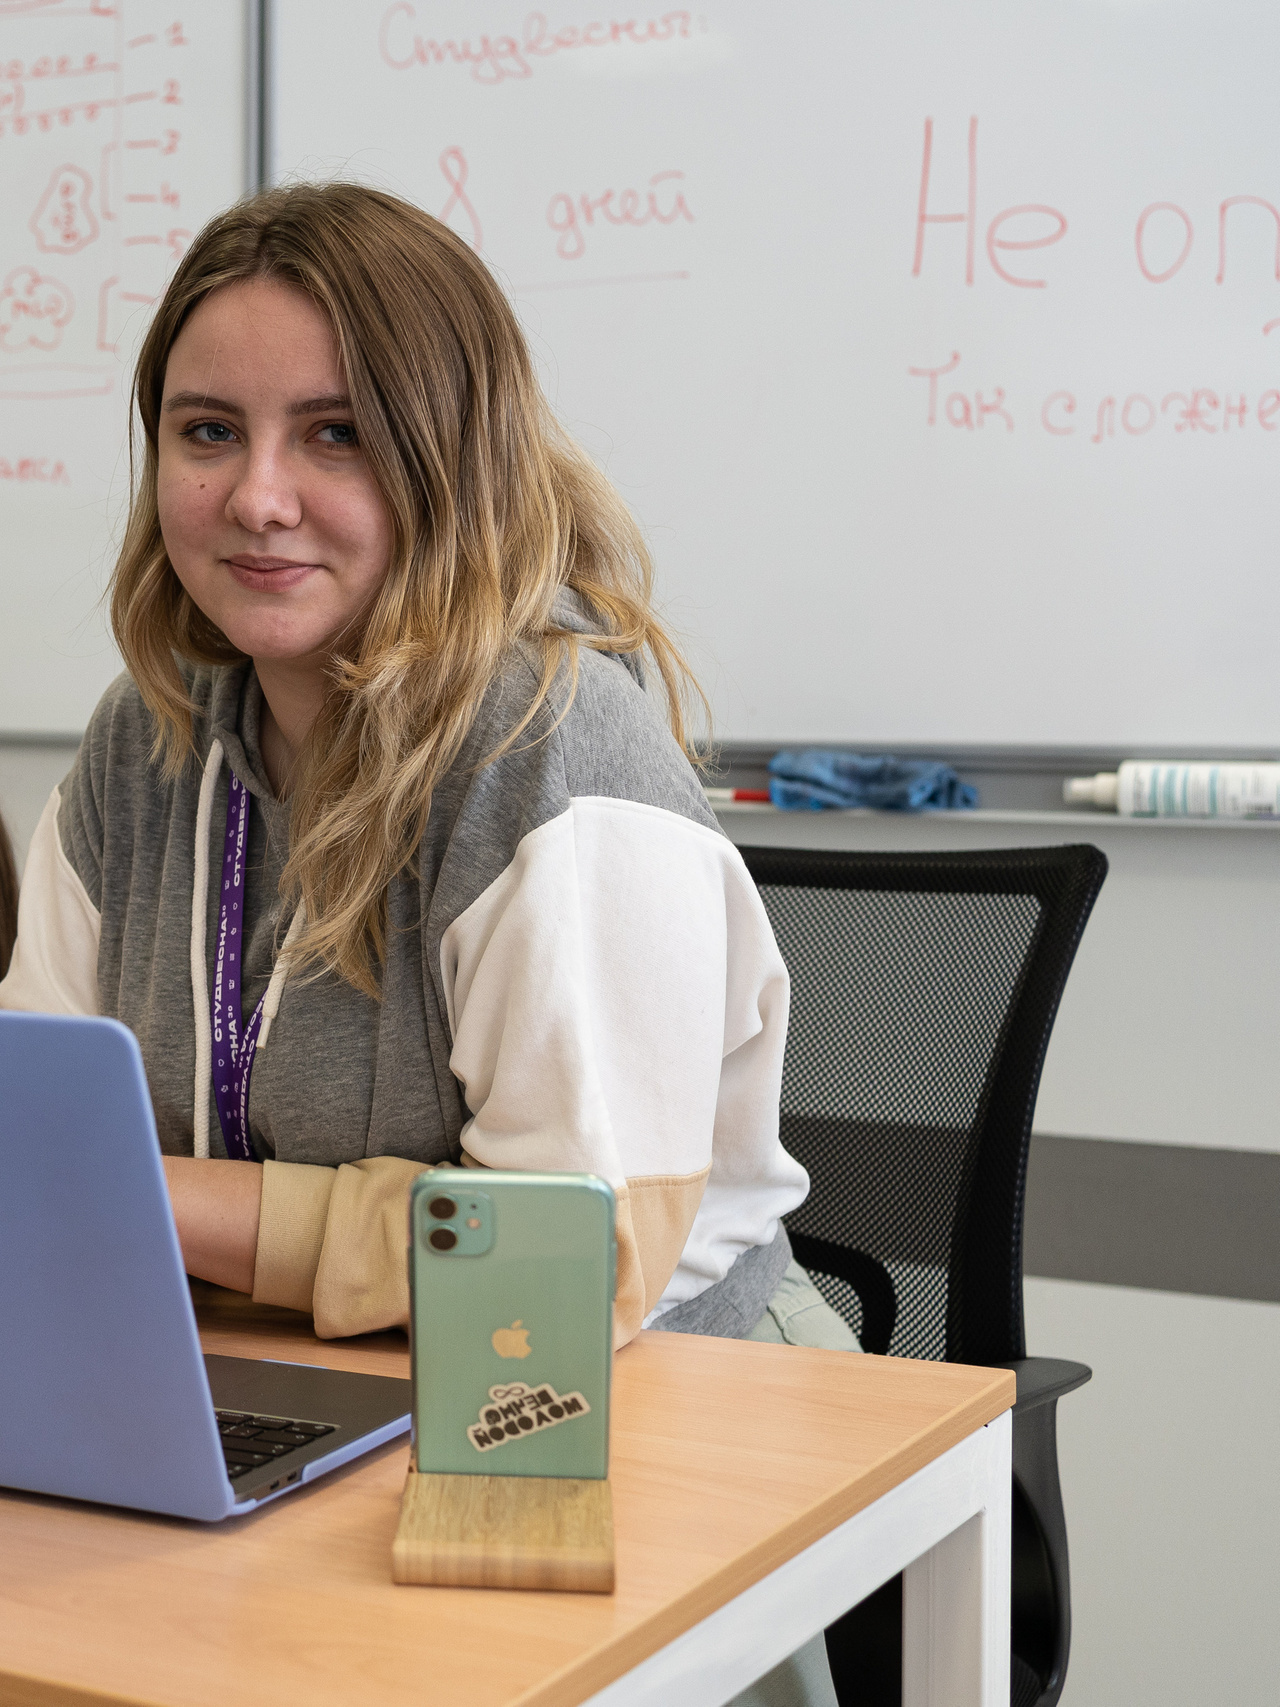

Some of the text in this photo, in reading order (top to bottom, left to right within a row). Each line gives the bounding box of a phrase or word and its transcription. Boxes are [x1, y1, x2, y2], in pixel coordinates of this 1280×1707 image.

[546, 170, 695, 260] дней
[911, 115, 1069, 288] Не
[908, 351, 1014, 432] Так
